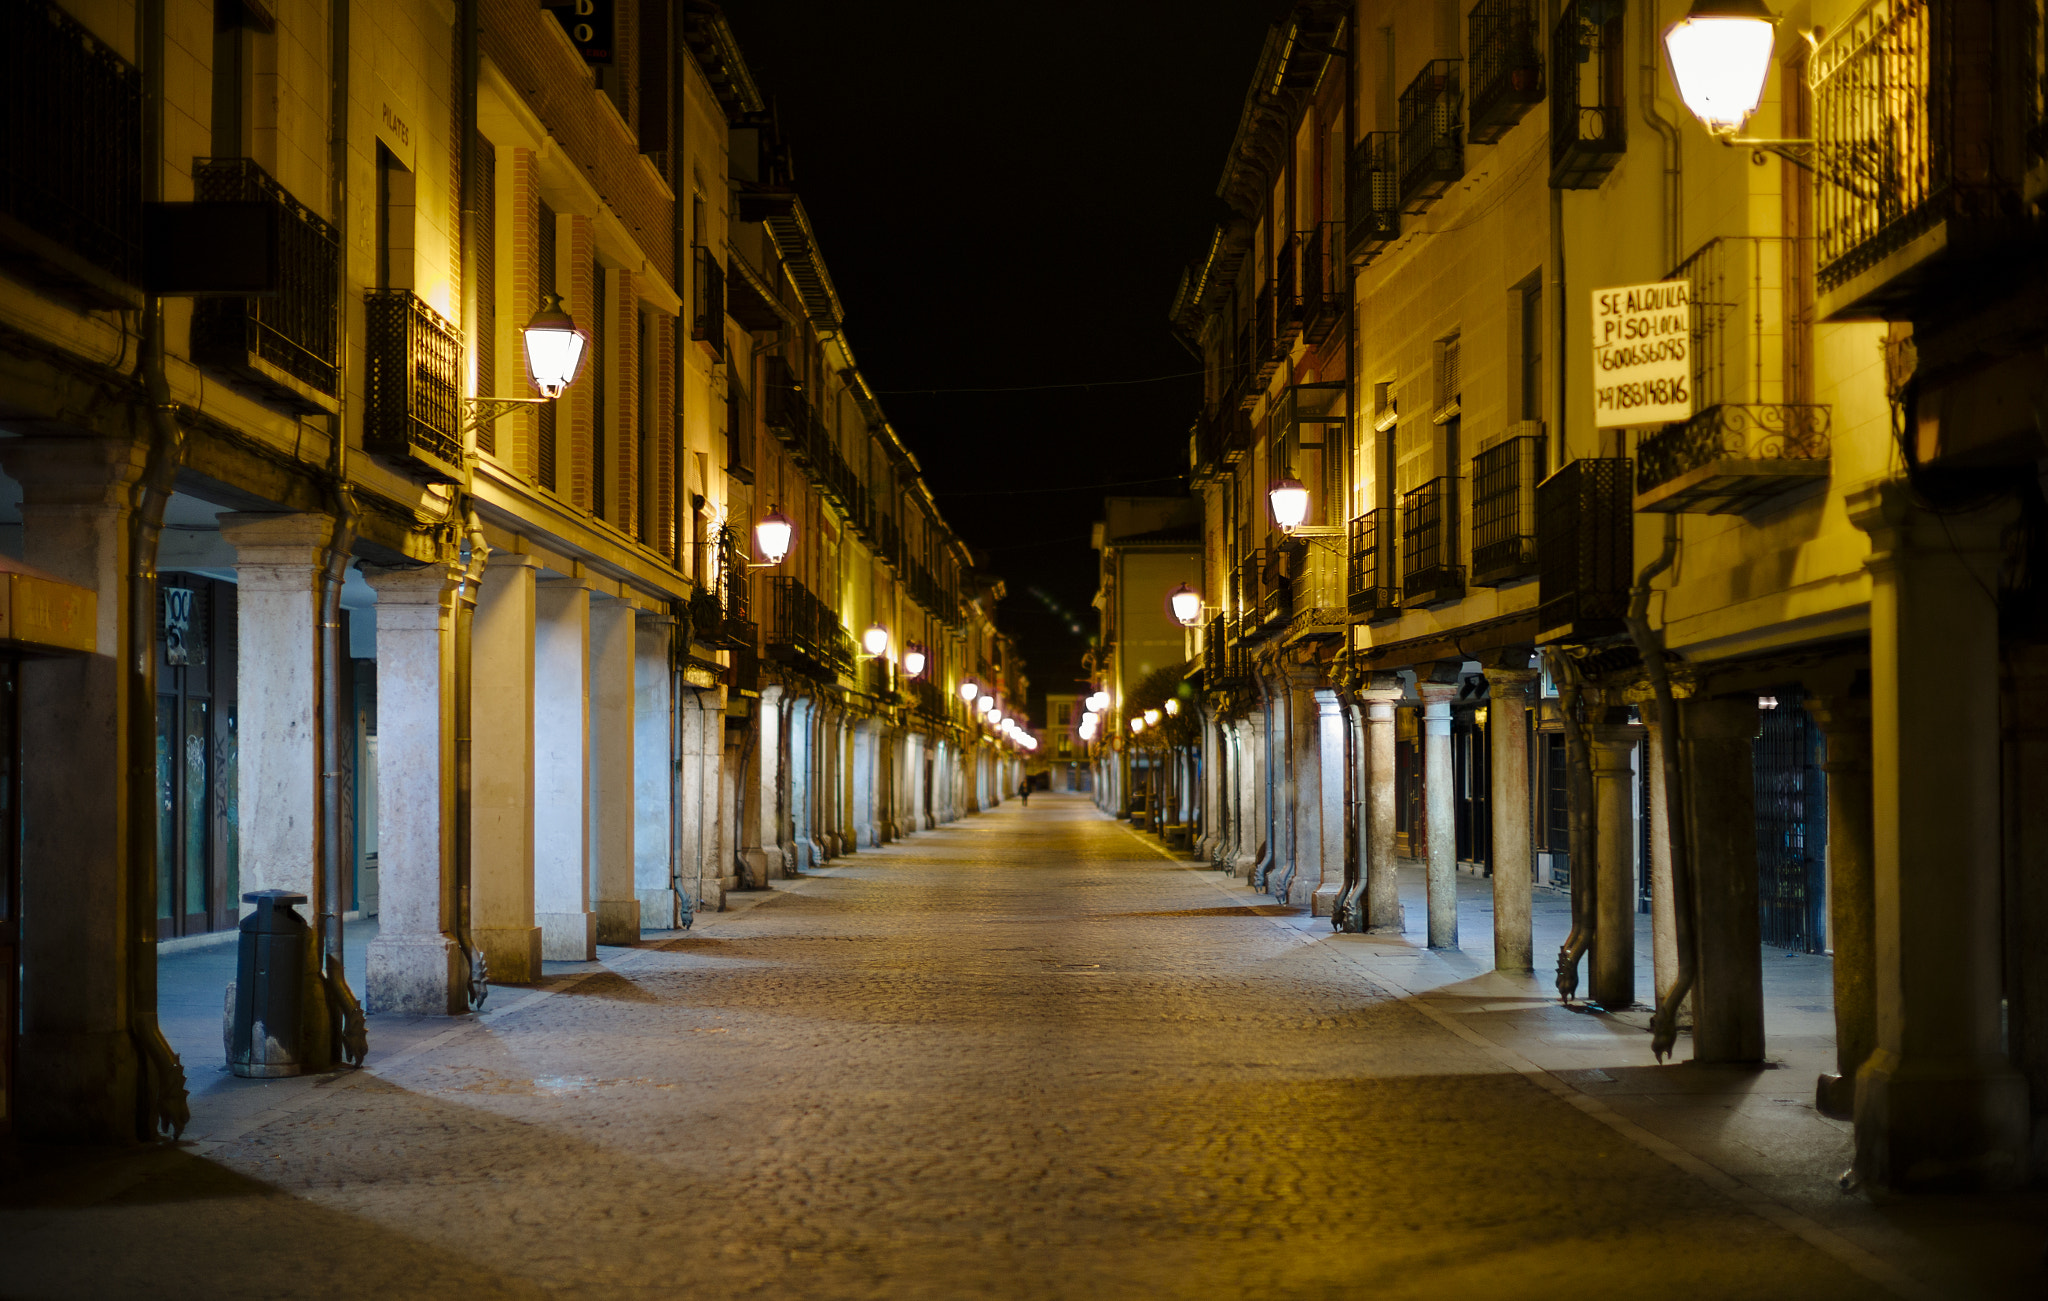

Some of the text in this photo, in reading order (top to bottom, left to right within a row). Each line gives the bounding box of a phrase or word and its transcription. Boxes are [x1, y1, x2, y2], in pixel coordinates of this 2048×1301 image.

[382, 101, 409, 147] PILATES
[1600, 285, 1689, 316] SE ALQUILA
